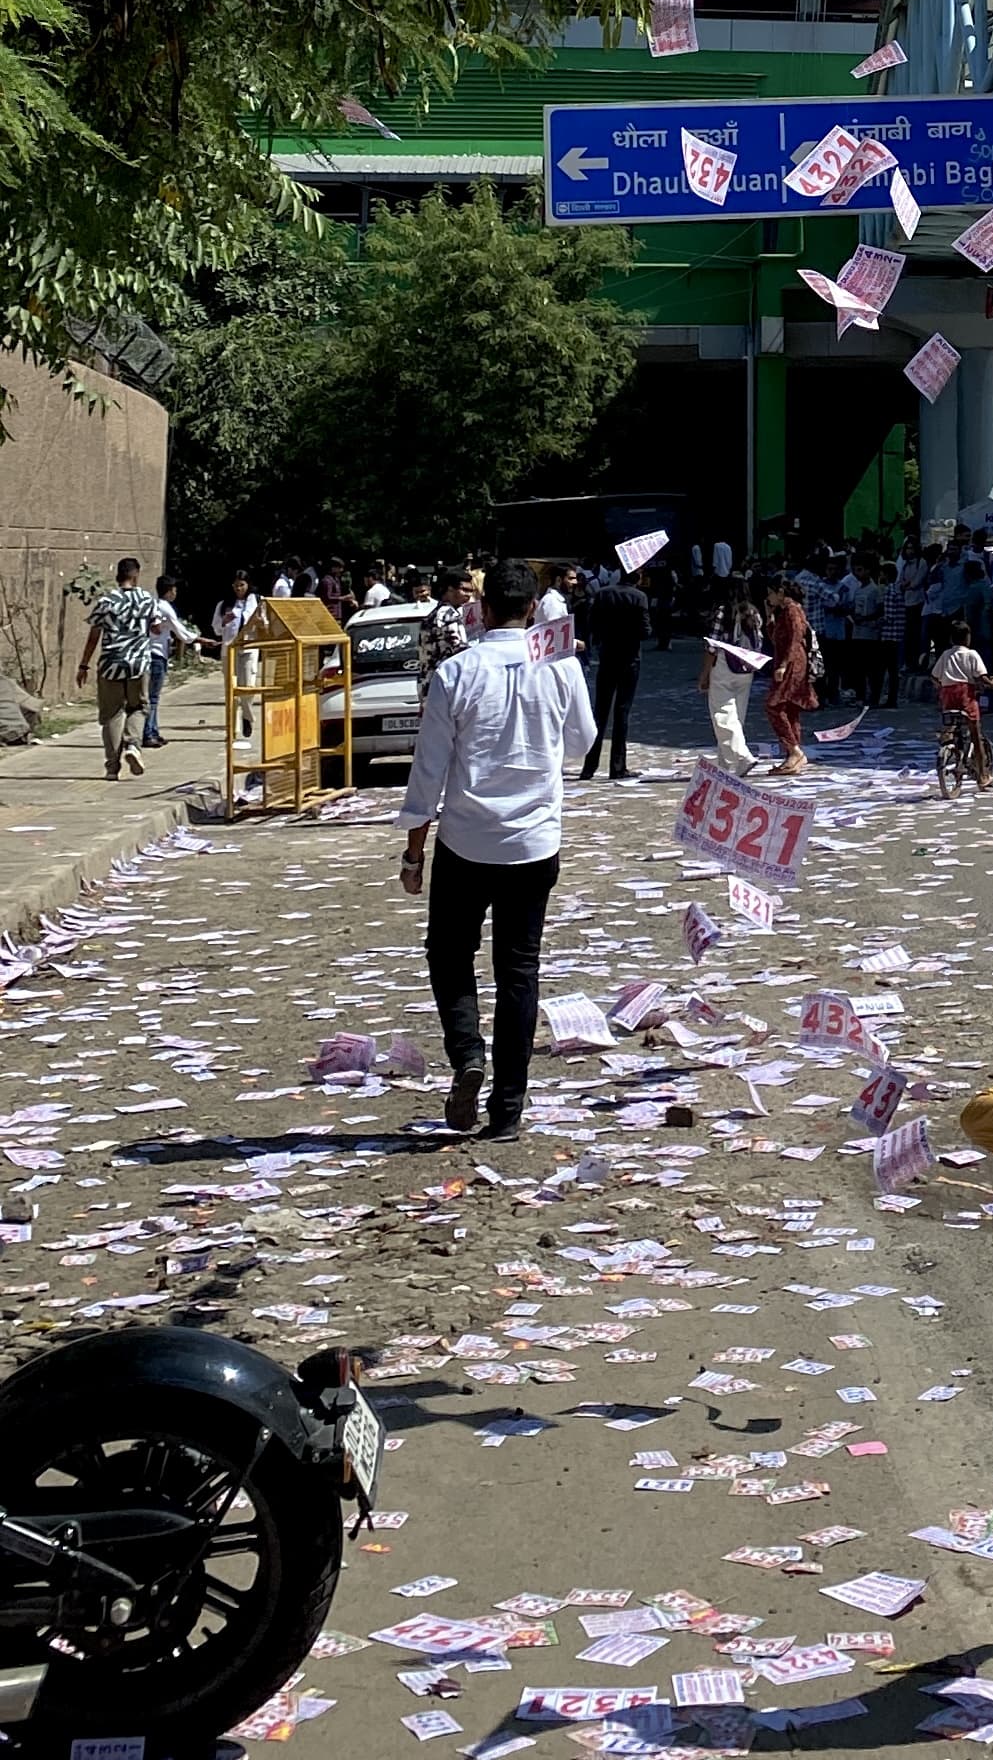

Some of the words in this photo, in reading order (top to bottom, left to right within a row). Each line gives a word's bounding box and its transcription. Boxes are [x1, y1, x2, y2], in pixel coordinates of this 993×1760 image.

[612, 122, 668, 148] धौला
[926, 121, 973, 139] बाग
[799, 134, 858, 195] 4321
[832, 142, 886, 203] 4321
[613, 172, 689, 195] Dhaul
[729, 173, 778, 193] uan
[864, 250, 901, 265] 4321
[530, 623, 571, 662] 321
[683, 779, 804, 866] 4321
[732, 884, 770, 923] 4321
[392, 1623, 498, 1649] 4321
[769, 1648, 838, 1674] 4321
[529, 1695, 652, 1714] 4321
